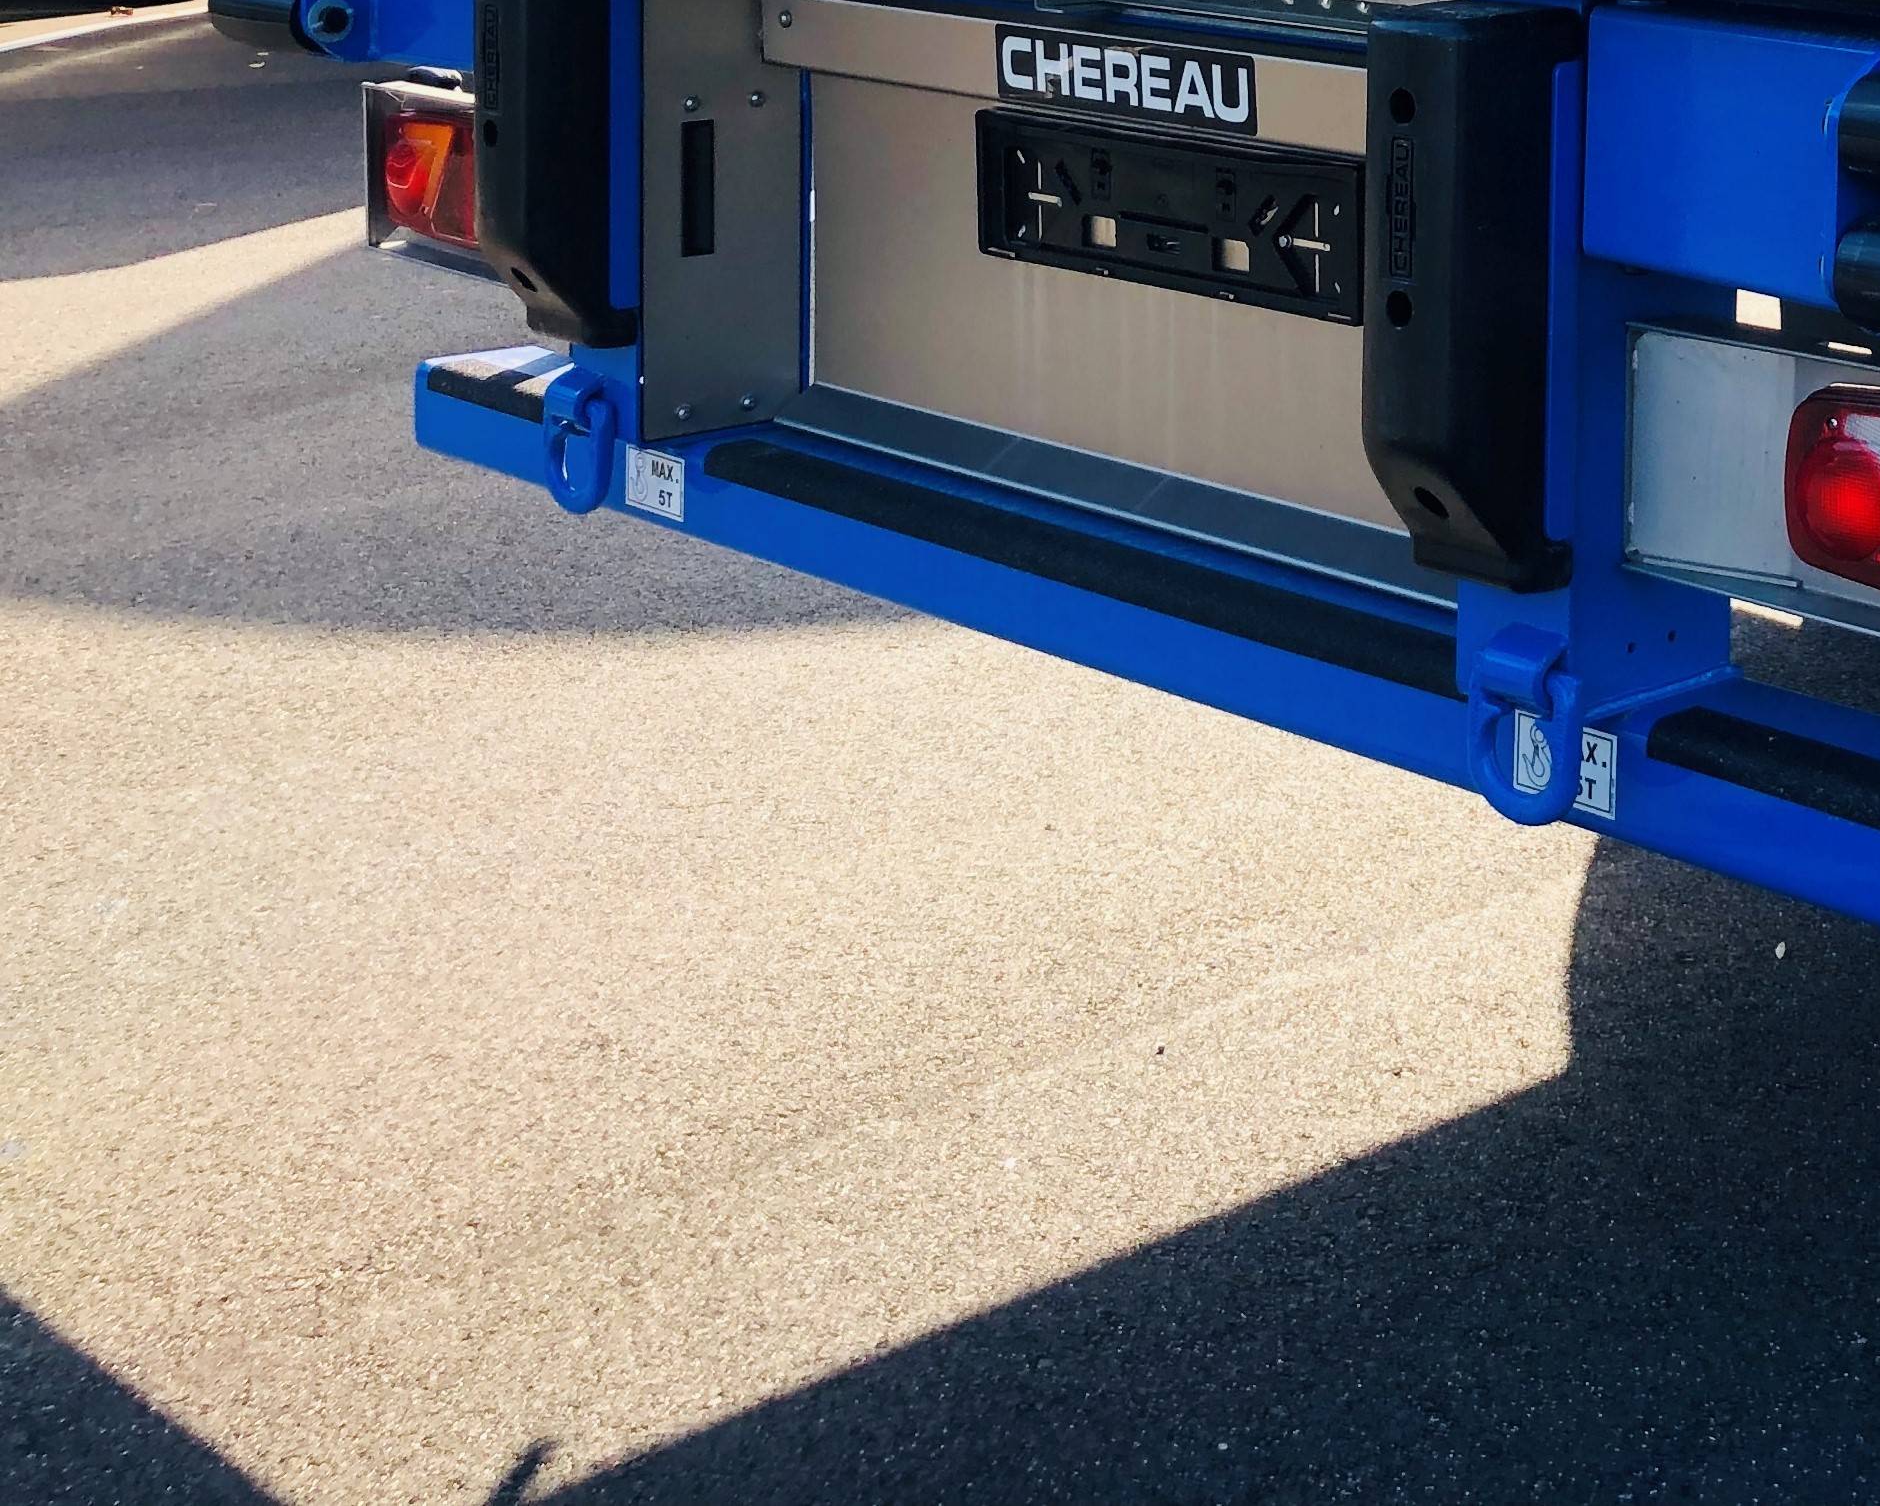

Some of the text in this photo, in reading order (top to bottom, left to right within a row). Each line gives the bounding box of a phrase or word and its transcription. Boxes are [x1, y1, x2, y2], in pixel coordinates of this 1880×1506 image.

[1002, 37, 1249, 123] CHEREAU
[1393, 140, 1411, 270] CHEREAU
[651, 460, 679, 483] MAX.
[658, 490, 672, 507] 5T
